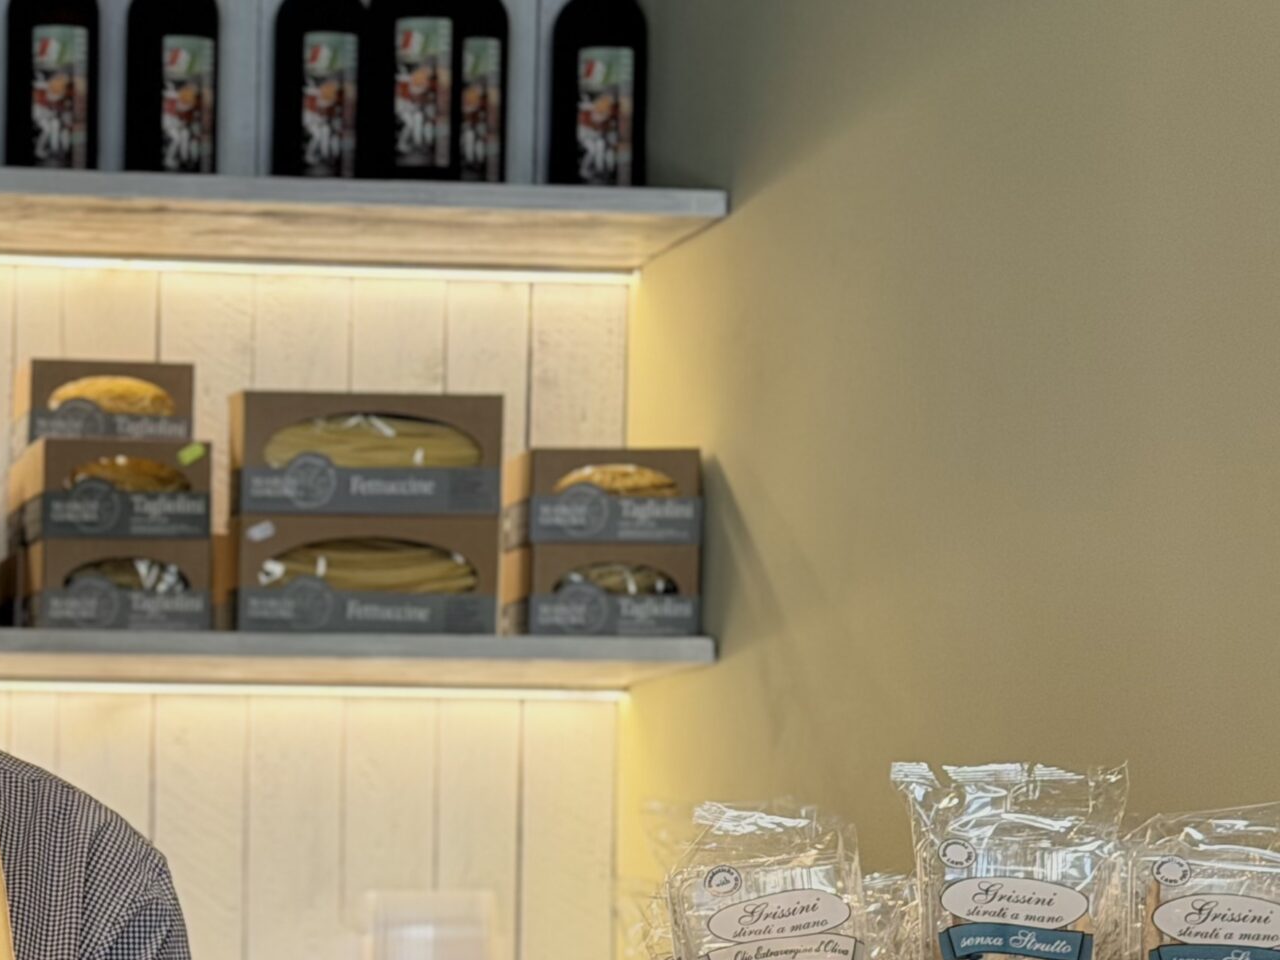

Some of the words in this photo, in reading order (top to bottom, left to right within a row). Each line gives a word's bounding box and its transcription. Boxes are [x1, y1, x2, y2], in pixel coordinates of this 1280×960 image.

[971, 880, 1058, 907] Grissini
[738, 897, 821, 926] Grissini
[966, 905, 1009, 920] stirati
[1010, 911, 1020, 921] a
[1023, 913, 1065, 924] mano
[1184, 899, 1274, 926] Grissini
[776, 925, 786, 935] a
[790, 919, 829, 934] mano
[1176, 925, 1222, 939] stirati
[1224, 931, 1234, 940] a
[1238, 931, 1279, 942] mano
[960, 936, 1004, 949] senza
[1009, 929, 1073, 954] Strutto
